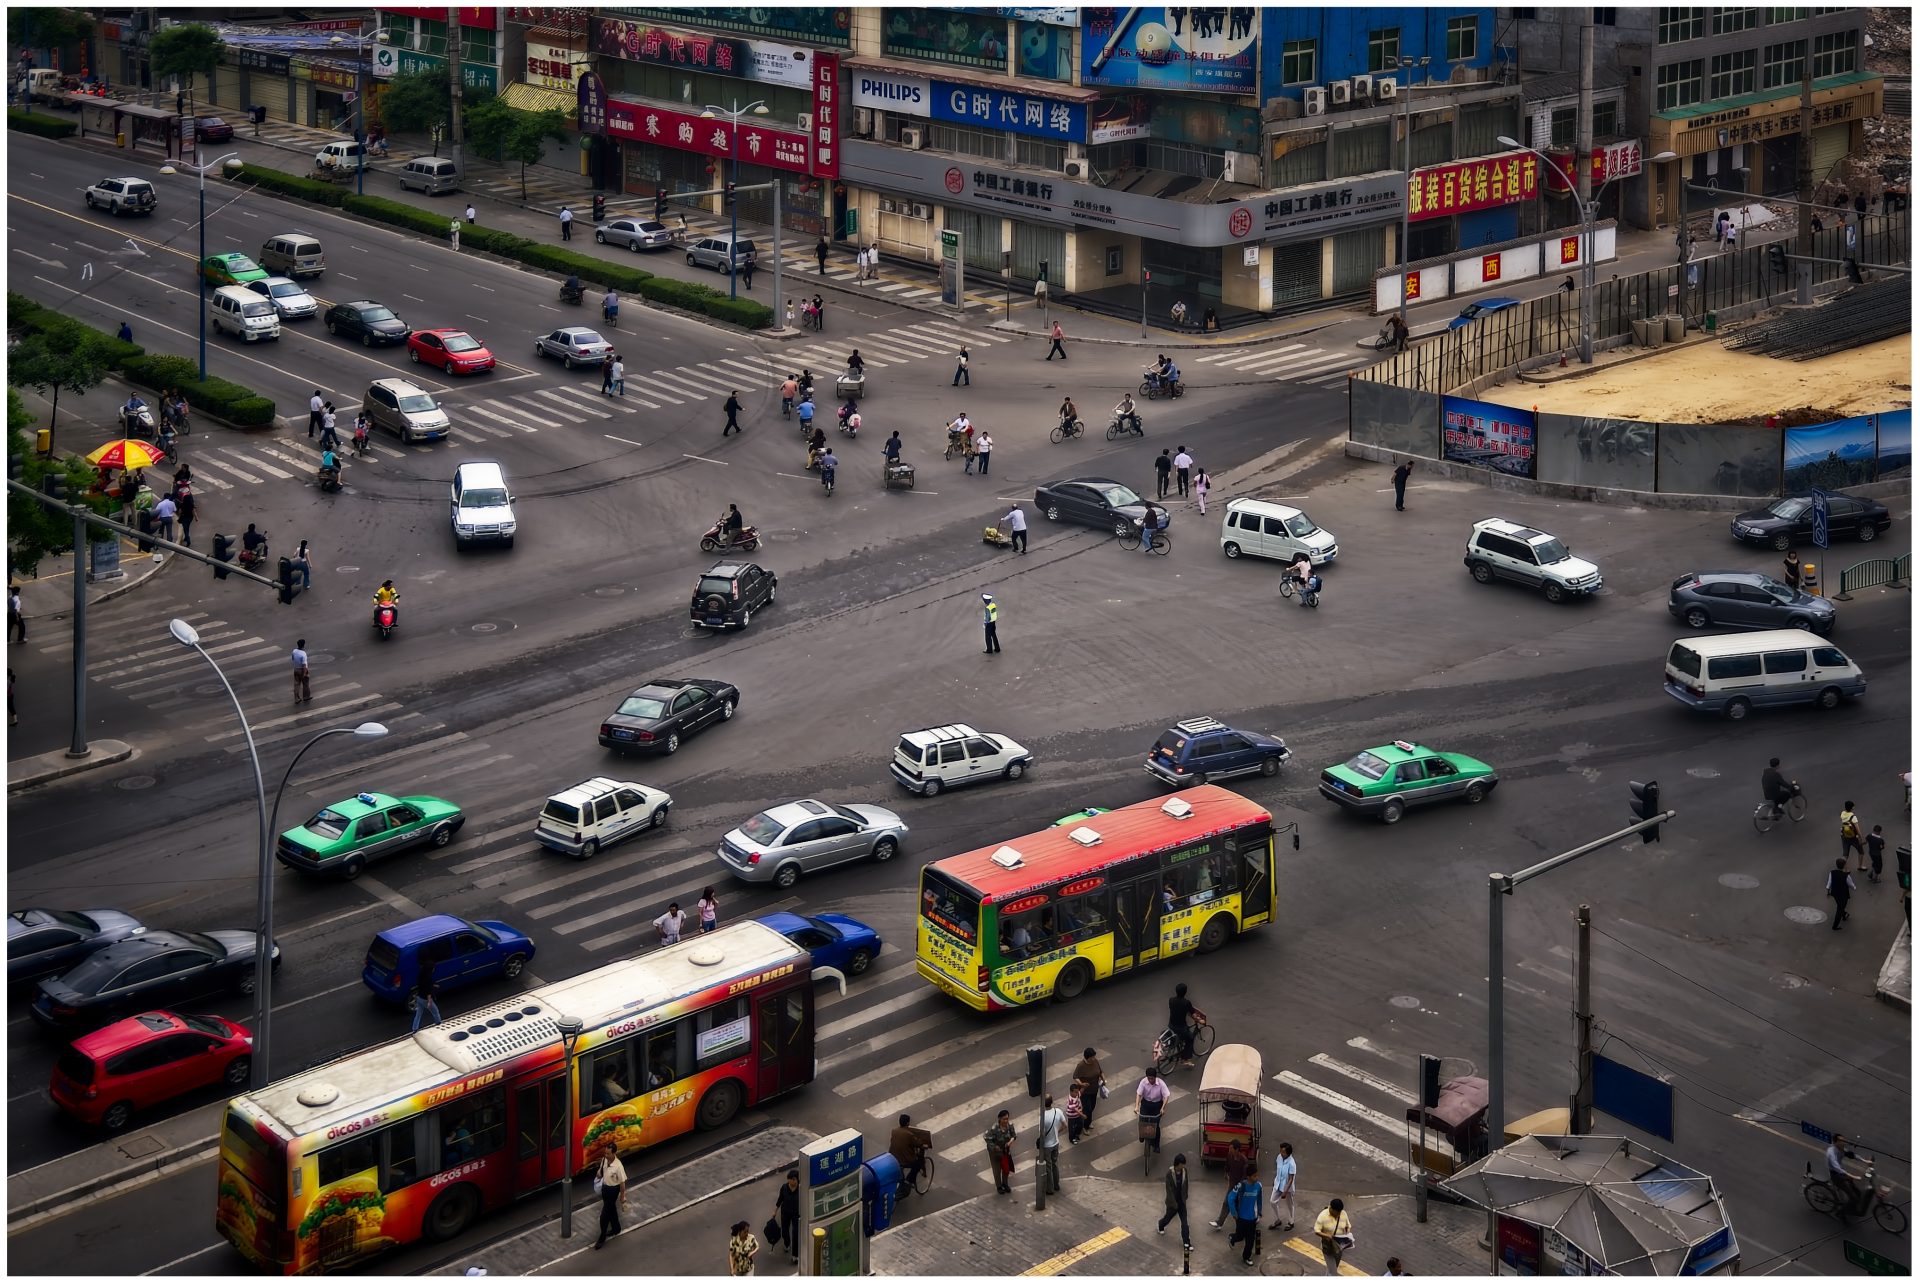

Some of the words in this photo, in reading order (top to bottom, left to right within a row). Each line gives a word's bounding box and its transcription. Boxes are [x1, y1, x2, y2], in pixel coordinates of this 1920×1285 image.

[626, 30, 734, 71] G时代网络
[1147, 35, 1154, 43] 9
[861, 79, 921, 103] PHILIPS
[818, 66, 832, 166] G时代网吧
[950, 90, 1071, 133] G时代网络
[646, 114, 762, 157] 赛购超市
[974, 171, 1053, 200] 中国工商银行
[1409, 155, 1536, 214] 服装百货综合超市
[1265, 188, 1352, 218] 中国工商银行
[1486, 259, 1499, 276] 西
[1563, 242, 1576, 259] 谐
[1447, 411, 1485, 430] 地铁施工
[1814, 492, 1825, 531] 驶入
